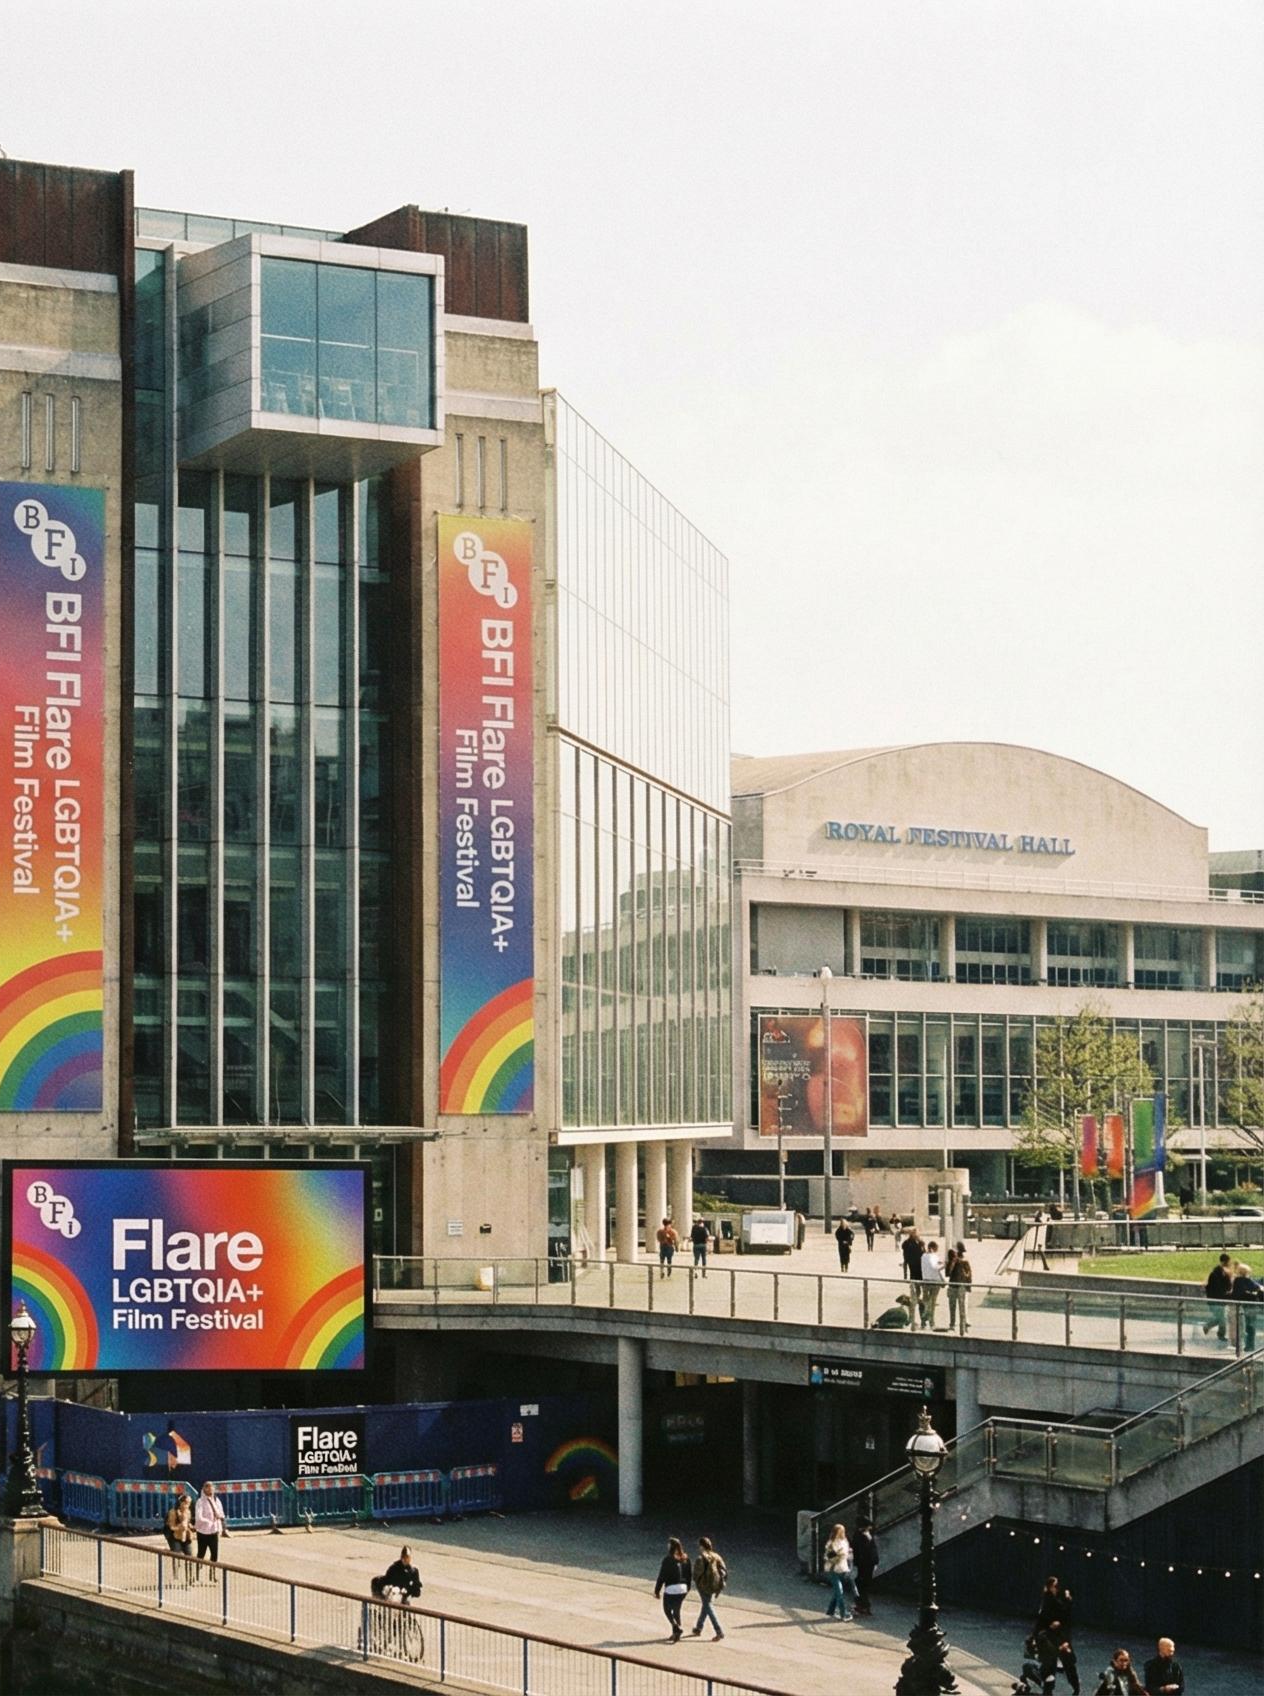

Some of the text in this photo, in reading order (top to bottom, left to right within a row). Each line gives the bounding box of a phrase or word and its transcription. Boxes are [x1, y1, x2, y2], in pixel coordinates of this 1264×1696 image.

[22, 504, 78, 577] BFI
[462, 537, 511, 604] BFI
[13, 705, 40, 895] Film Festival
[45, 592, 82, 943] BFI Flare LGBTQIA+
[481, 618, 514, 952] BFI Flare LGBTQIA+
[456, 729, 480, 908] Film Festival
[826, 821, 1076, 856] ROYAL FESTIVAL HALL
[112, 1218, 264, 1271] Flare
[112, 1278, 264, 1304] LGBTQIA+
[113, 1309, 264, 1330] Film Festival
[298, 1427, 357, 1450] Flare
